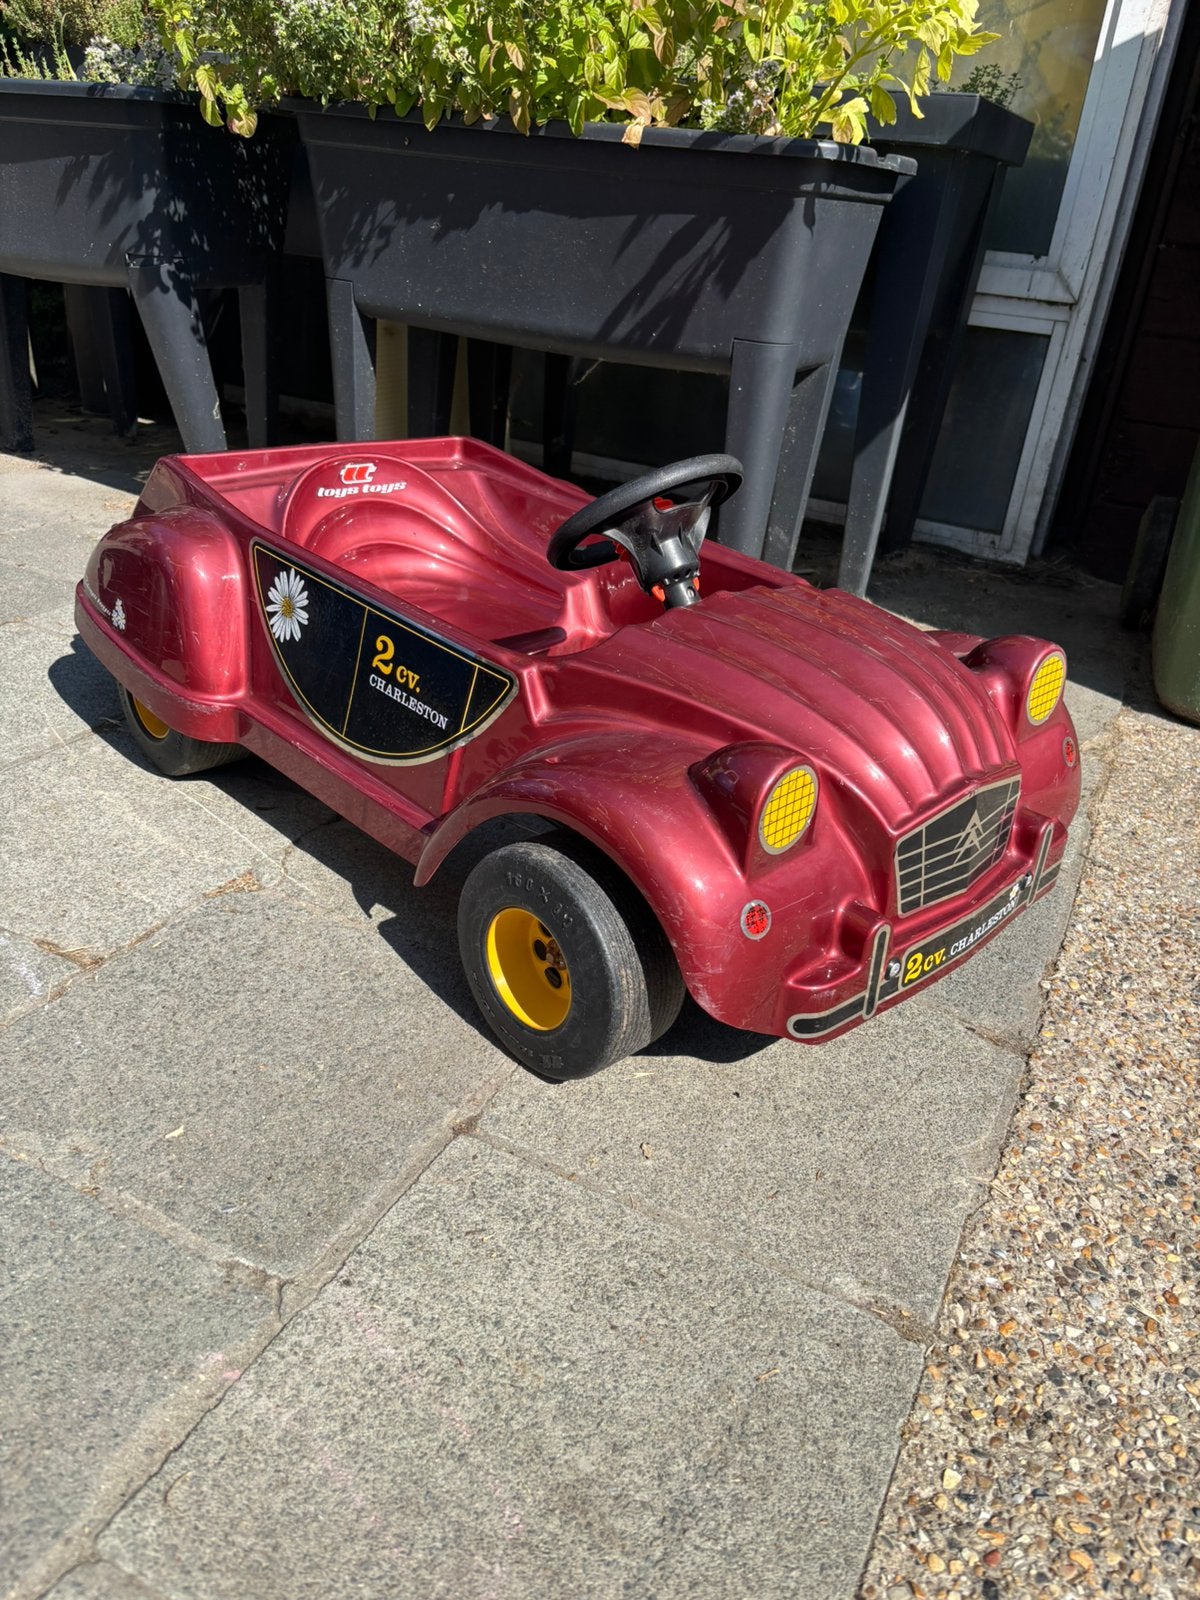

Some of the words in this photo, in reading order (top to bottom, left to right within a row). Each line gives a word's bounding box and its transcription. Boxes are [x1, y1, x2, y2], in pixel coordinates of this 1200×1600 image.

[317, 486, 359, 498] toys
[362, 481, 407, 494] toys
[372, 635, 395, 675] 2
[369, 673, 449, 730] CHARLESTON
[904, 953, 923, 984] 2
[949, 897, 1017, 956] CHARLESTON
